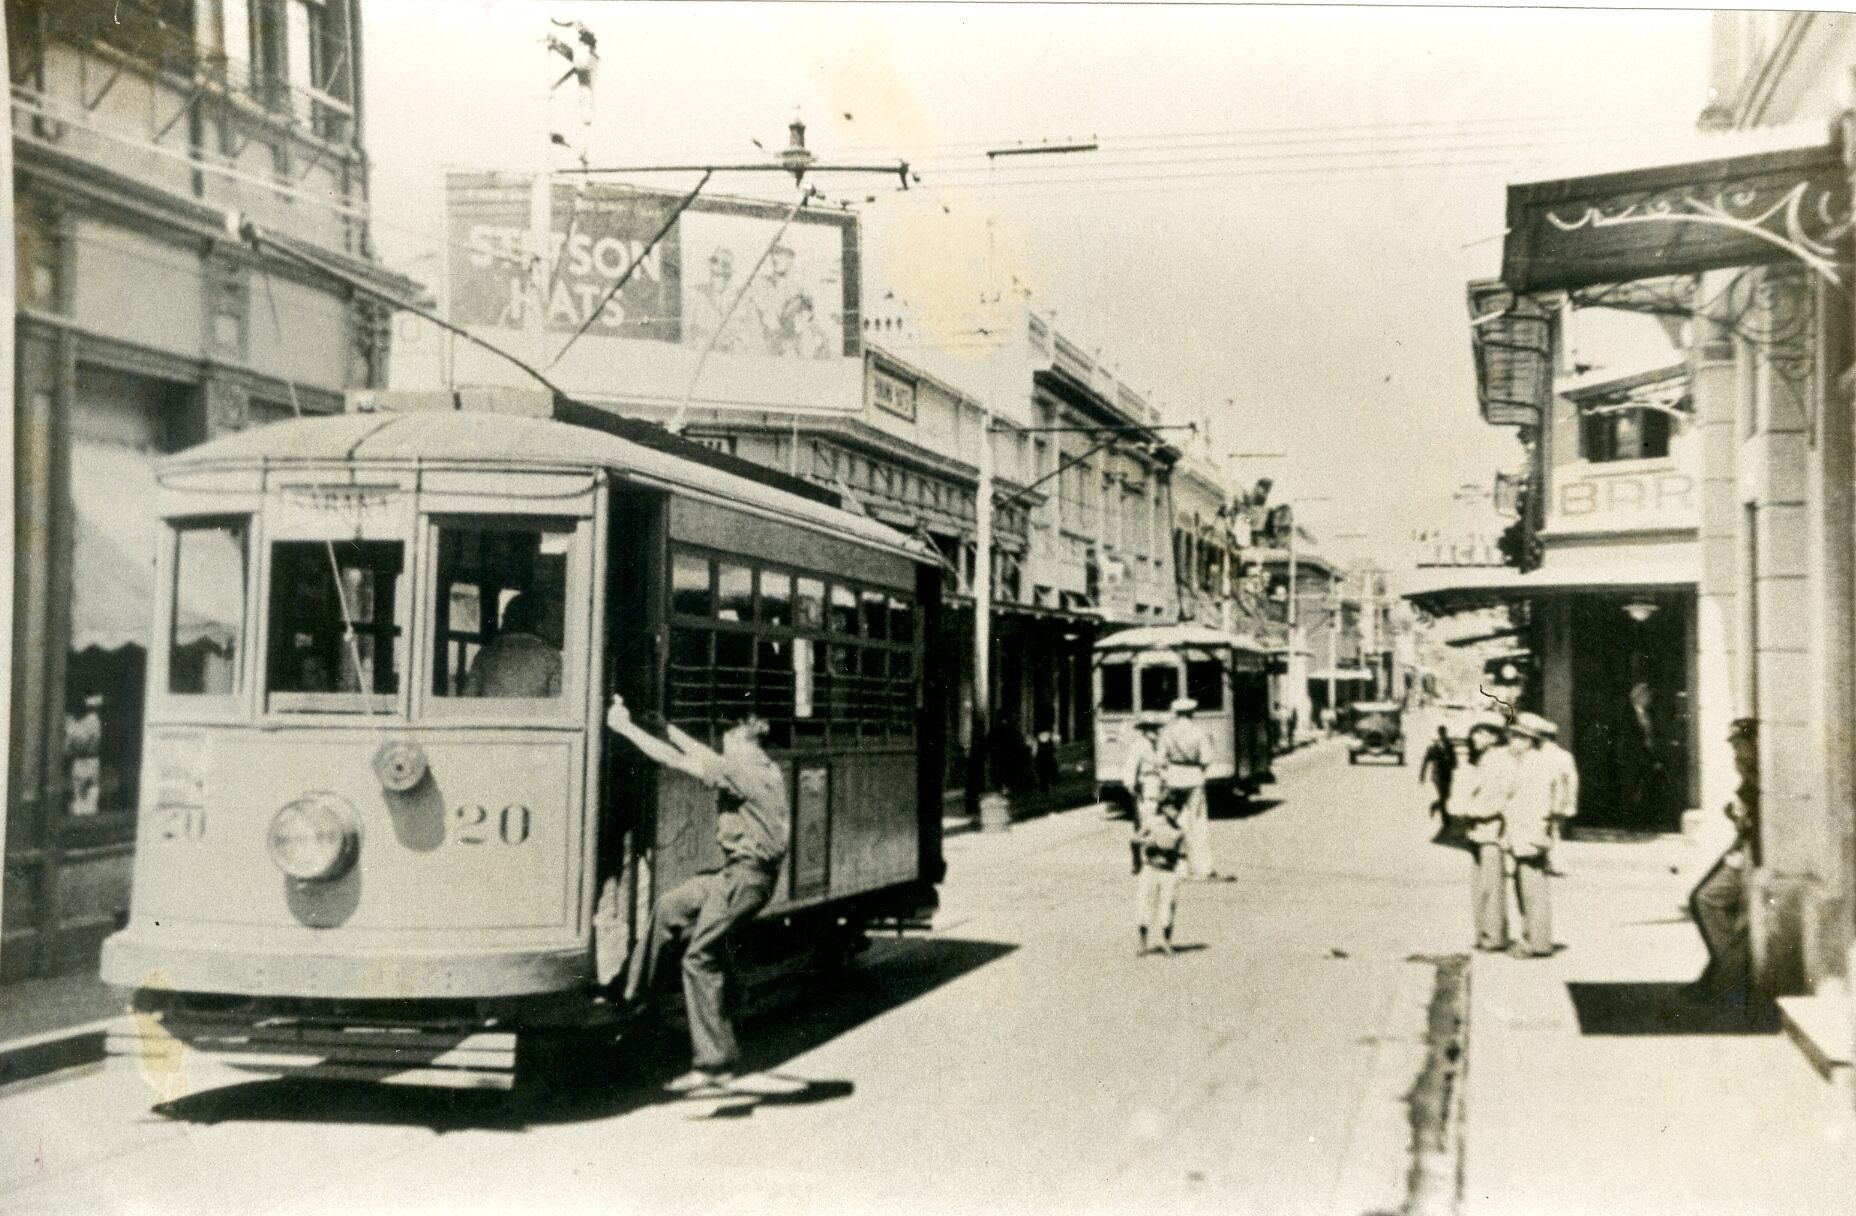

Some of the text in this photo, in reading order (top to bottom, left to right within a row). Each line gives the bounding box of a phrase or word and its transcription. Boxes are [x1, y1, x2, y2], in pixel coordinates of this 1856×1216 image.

[510, 276, 625, 327] HATS
[1560, 475, 1696, 516] BAR
[456, 804, 530, 845] 20
